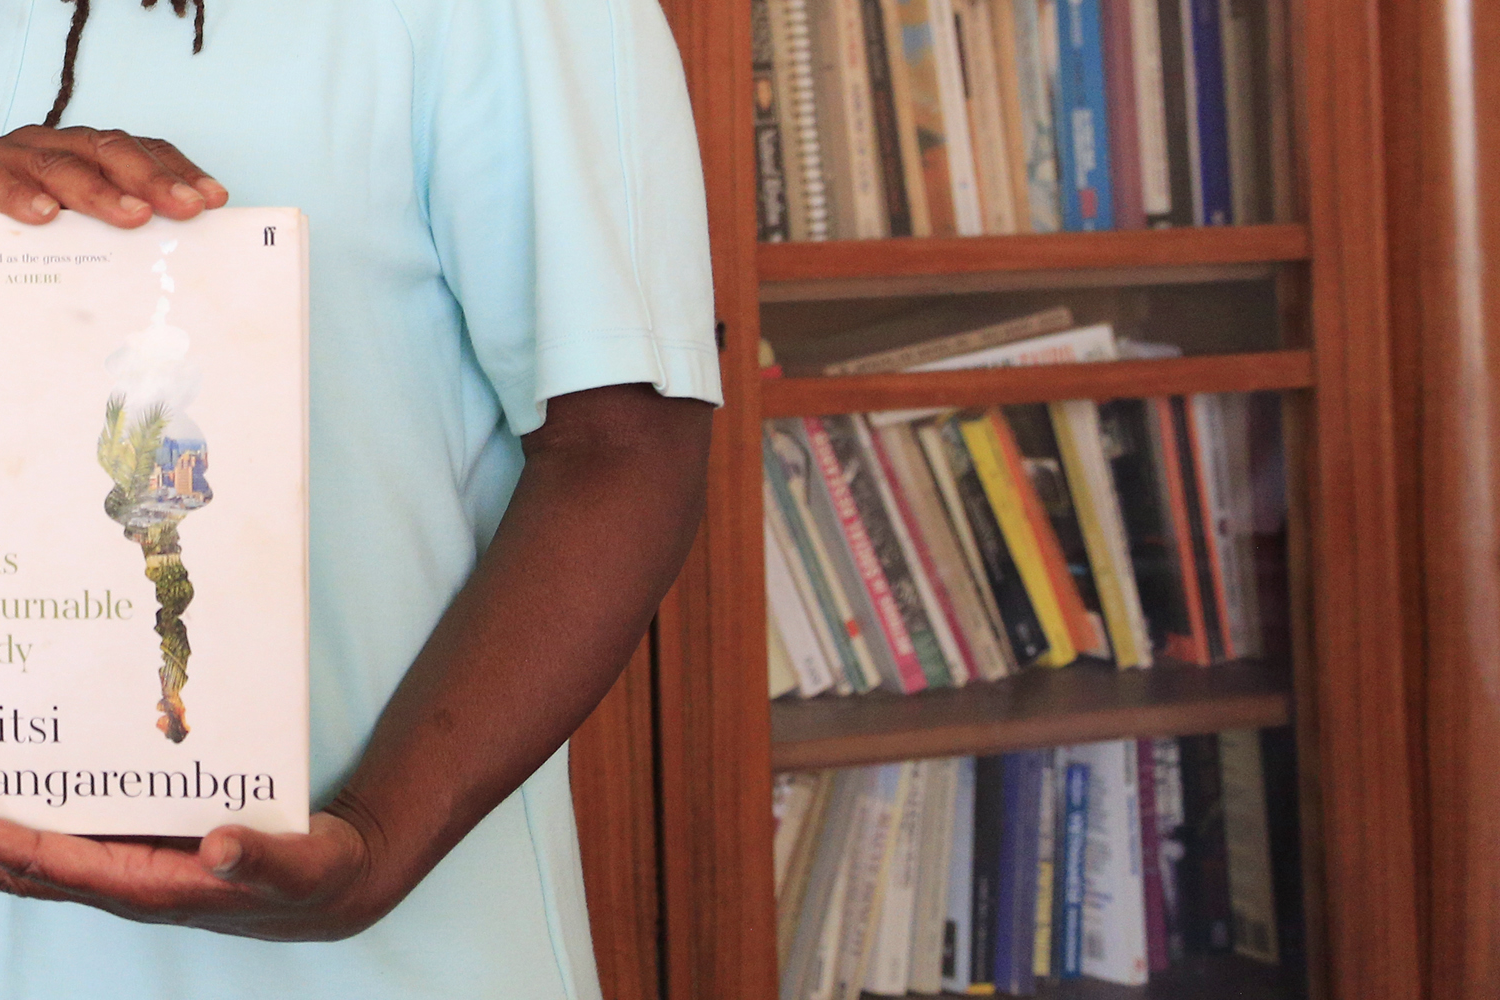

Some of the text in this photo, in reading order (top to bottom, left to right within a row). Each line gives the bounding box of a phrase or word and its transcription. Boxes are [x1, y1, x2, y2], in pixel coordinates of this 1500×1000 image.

[6, 255, 19, 264] as
[21, 253, 40, 264] the
[42, 255, 73, 266] grass
[4, 273, 63, 284] ACHEBE
